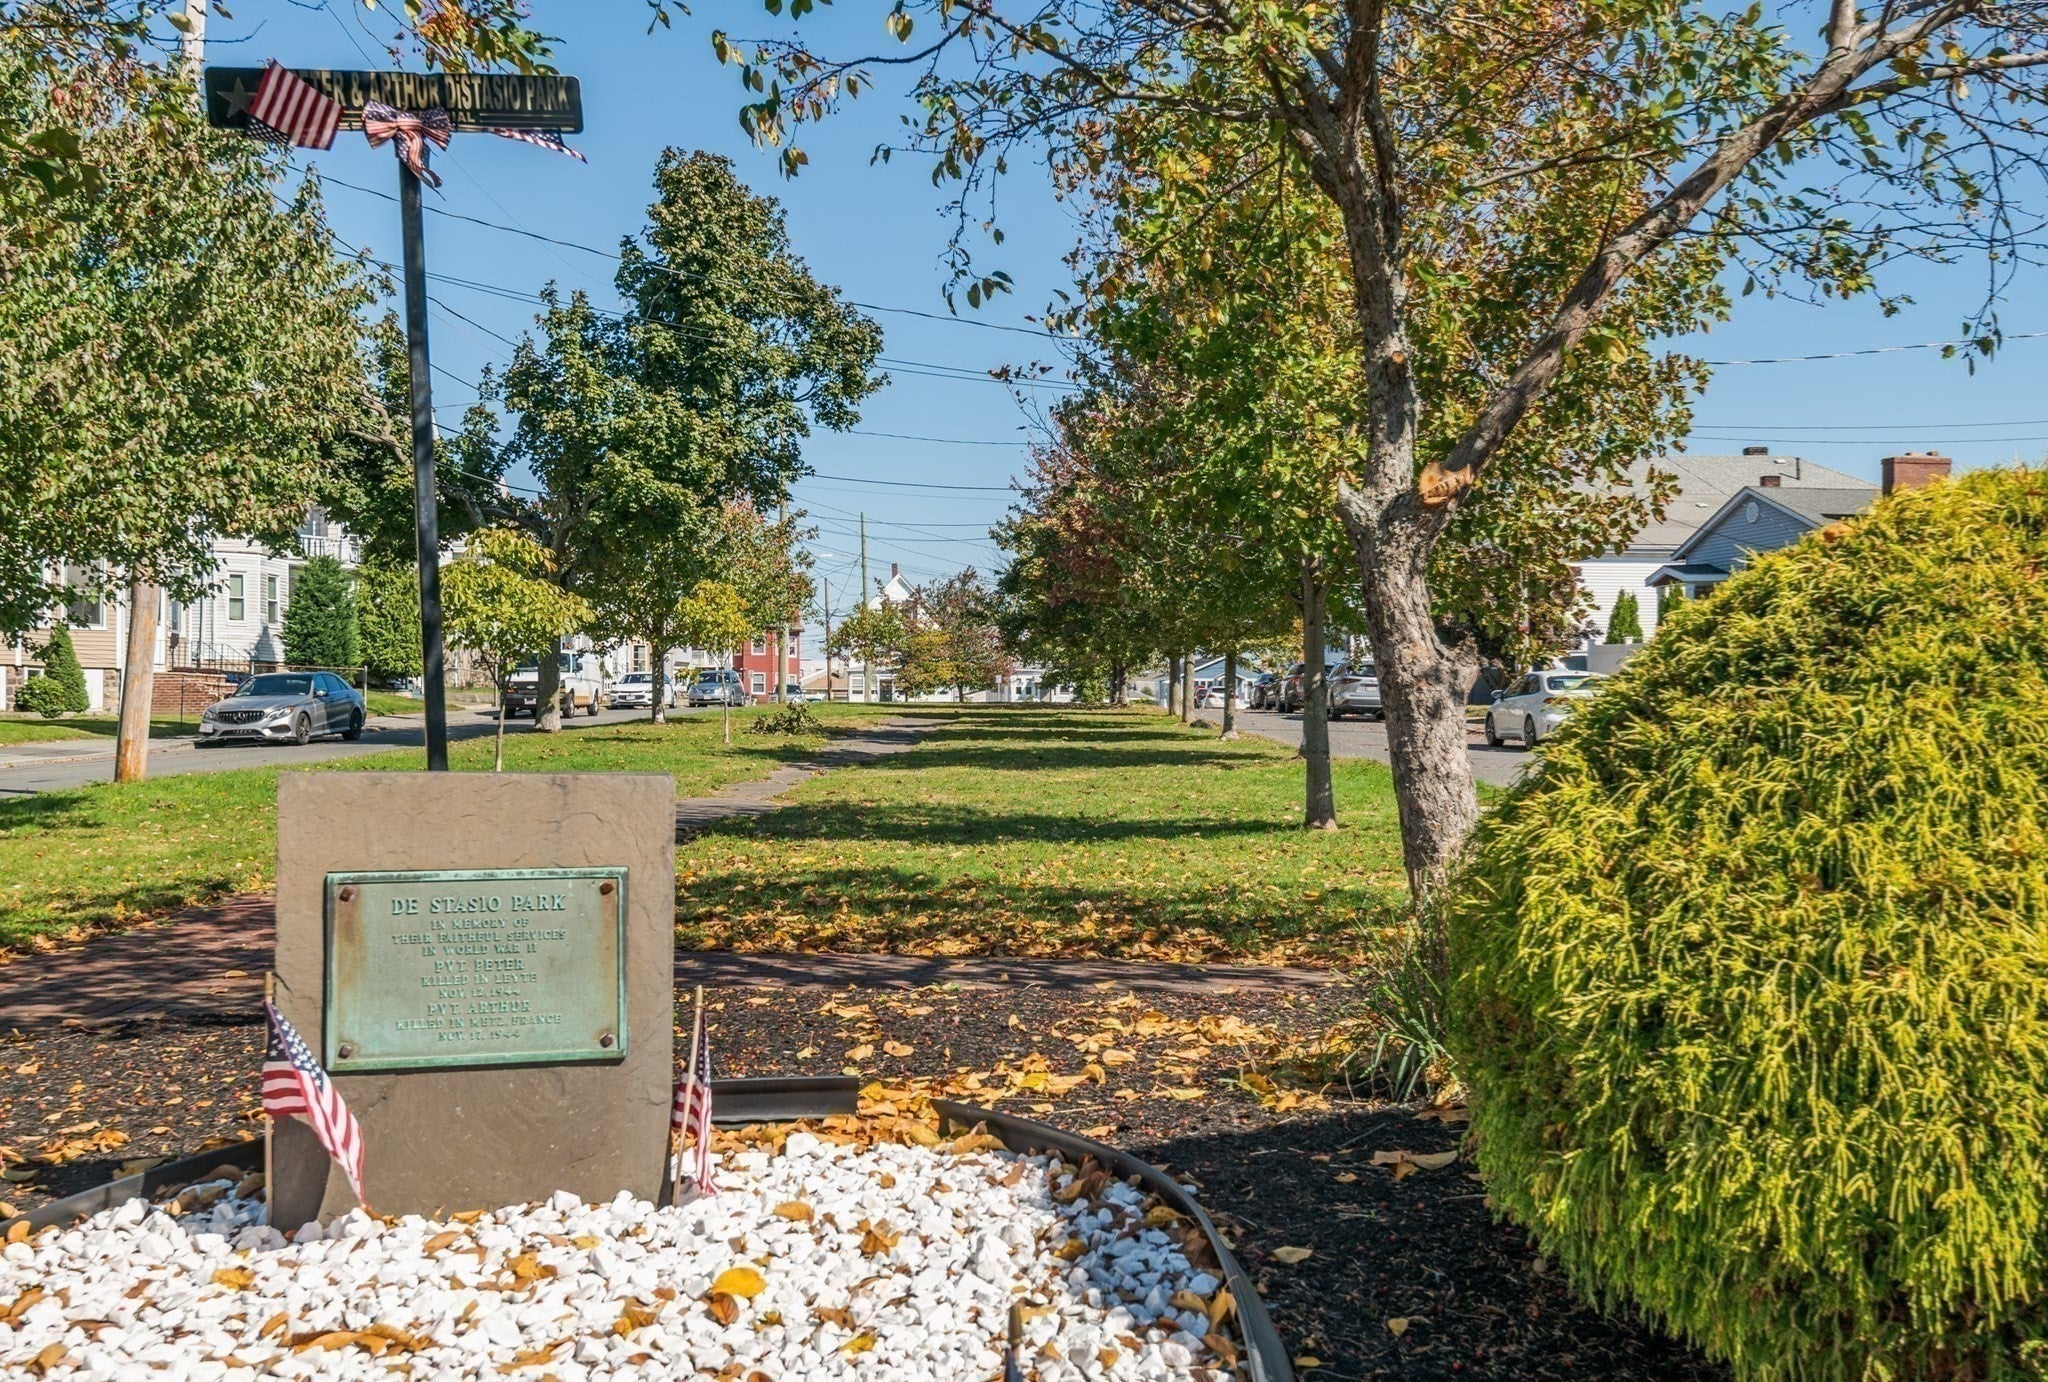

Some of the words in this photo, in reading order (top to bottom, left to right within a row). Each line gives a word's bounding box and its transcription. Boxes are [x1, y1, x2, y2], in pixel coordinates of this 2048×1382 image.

[351, 71, 365, 108] &
[369, 71, 440, 109] ARTHUR
[525, 75, 570, 111] PARK
[392, 897, 418, 915] DE
[430, 896, 501, 914] STASIO
[512, 894, 566, 912] PARK
[431, 920, 446, 931] IN
[452, 919, 507, 930] MEMORY
[513, 918, 529, 928] OF
[392, 933, 432, 945] THEIR
[438, 931, 501, 944] FAITHFUL
[507, 929, 566, 942] SERVICES
[422, 946, 437, 957] IN
[443, 945, 489, 956] WORLD
[494, 944, 520, 955] WAR
[474, 958, 526, 972] PETER
[421, 975, 468, 987] KILLED
[474, 974, 489, 985] IN
[494, 973, 537, 985] LEYTE
[490, 986, 521, 997] 1944
[467, 1000, 531, 1015] ARTHUR
[396, 1019, 443, 1031] KILLED
[449, 1018, 464, 1029] IN
[511, 1014, 562, 1026] FRANCE
